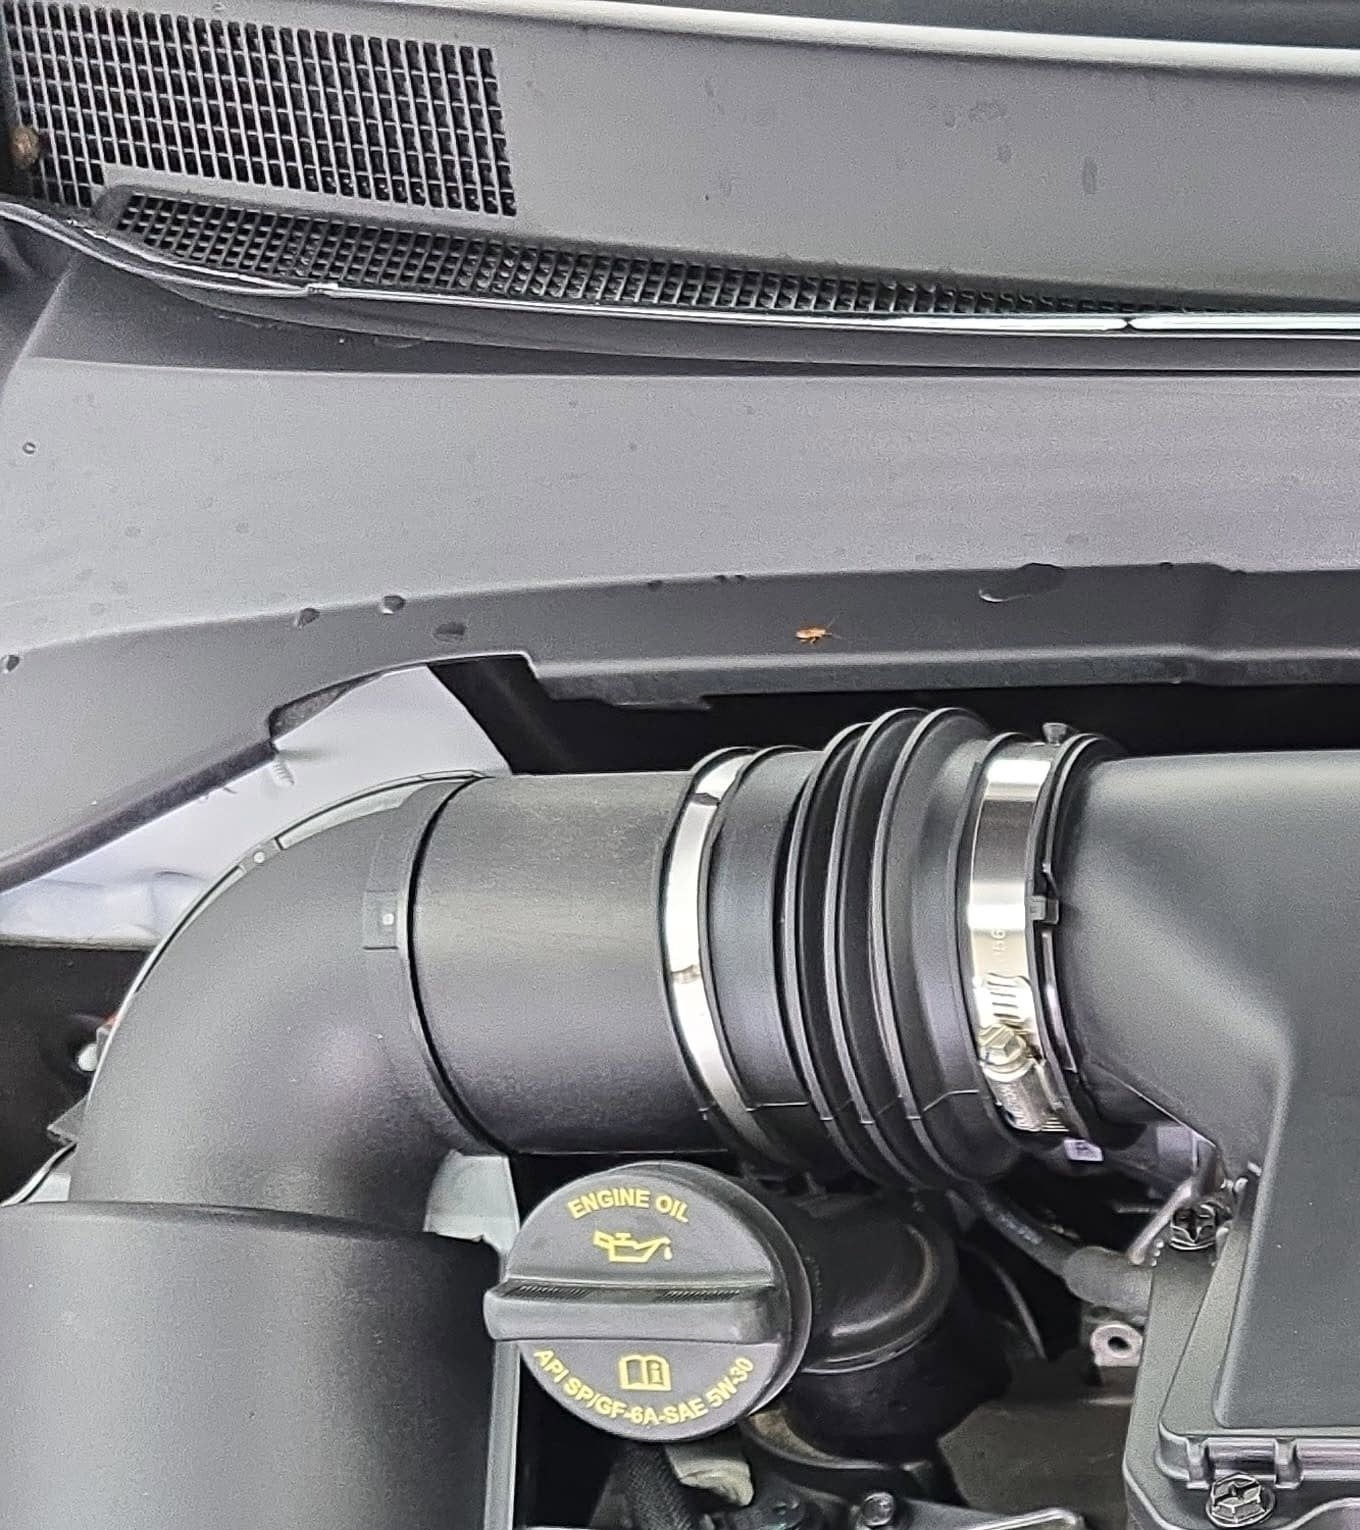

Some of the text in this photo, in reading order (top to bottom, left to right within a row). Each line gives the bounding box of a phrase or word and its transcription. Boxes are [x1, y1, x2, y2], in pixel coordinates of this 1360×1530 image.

[567, 1188, 689, 1222] ENGINE OIL
[533, 1350, 562, 1383] API
[706, 1357, 755, 1408] 5W-30
